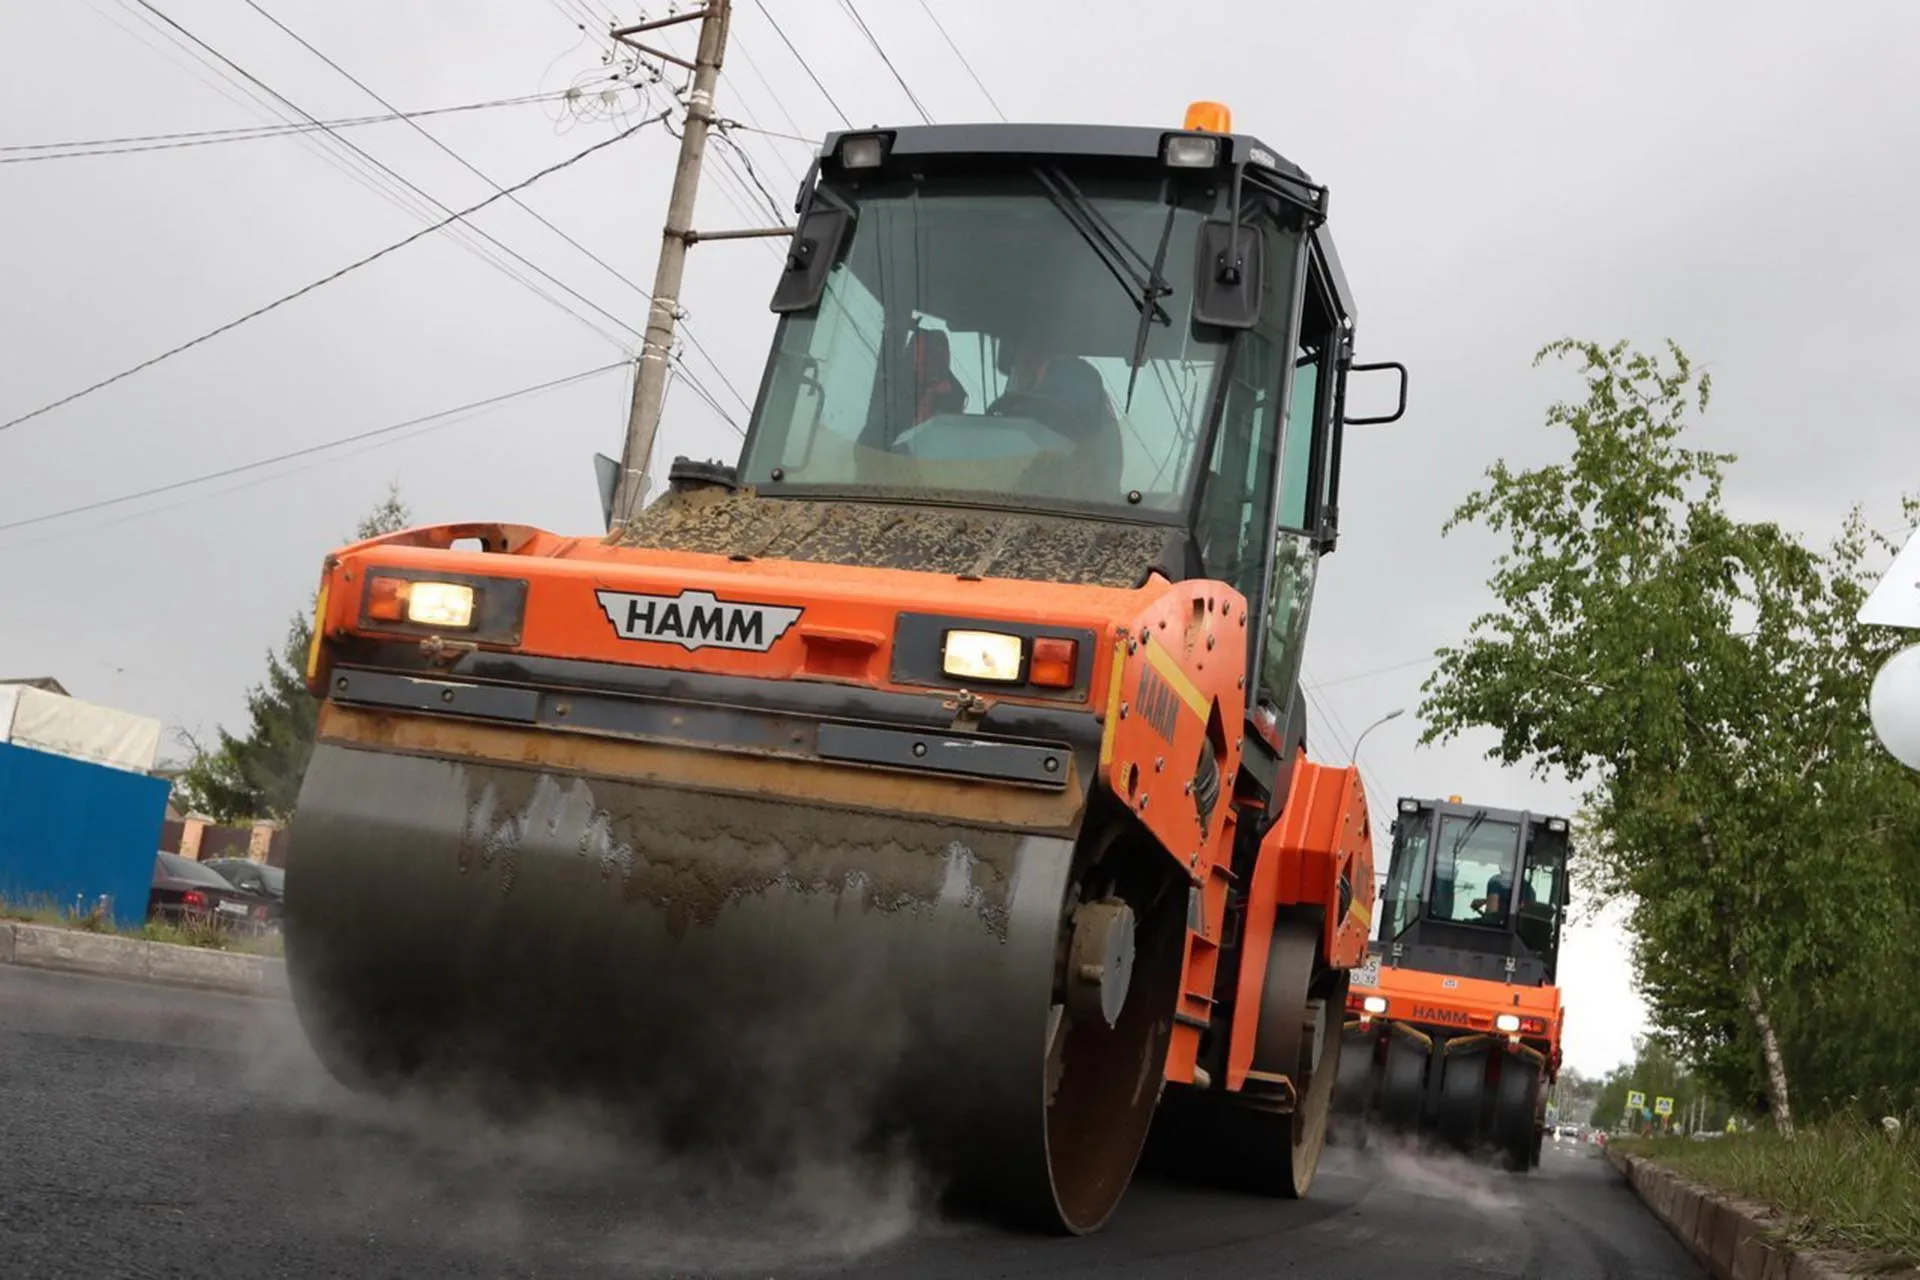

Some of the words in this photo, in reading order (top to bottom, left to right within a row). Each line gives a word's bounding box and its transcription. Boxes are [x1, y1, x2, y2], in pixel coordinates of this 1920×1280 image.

[626, 600, 763, 645] HAMM
[1135, 663, 1179, 746] HAMM
[1412, 1004, 1469, 1026] HAMM
